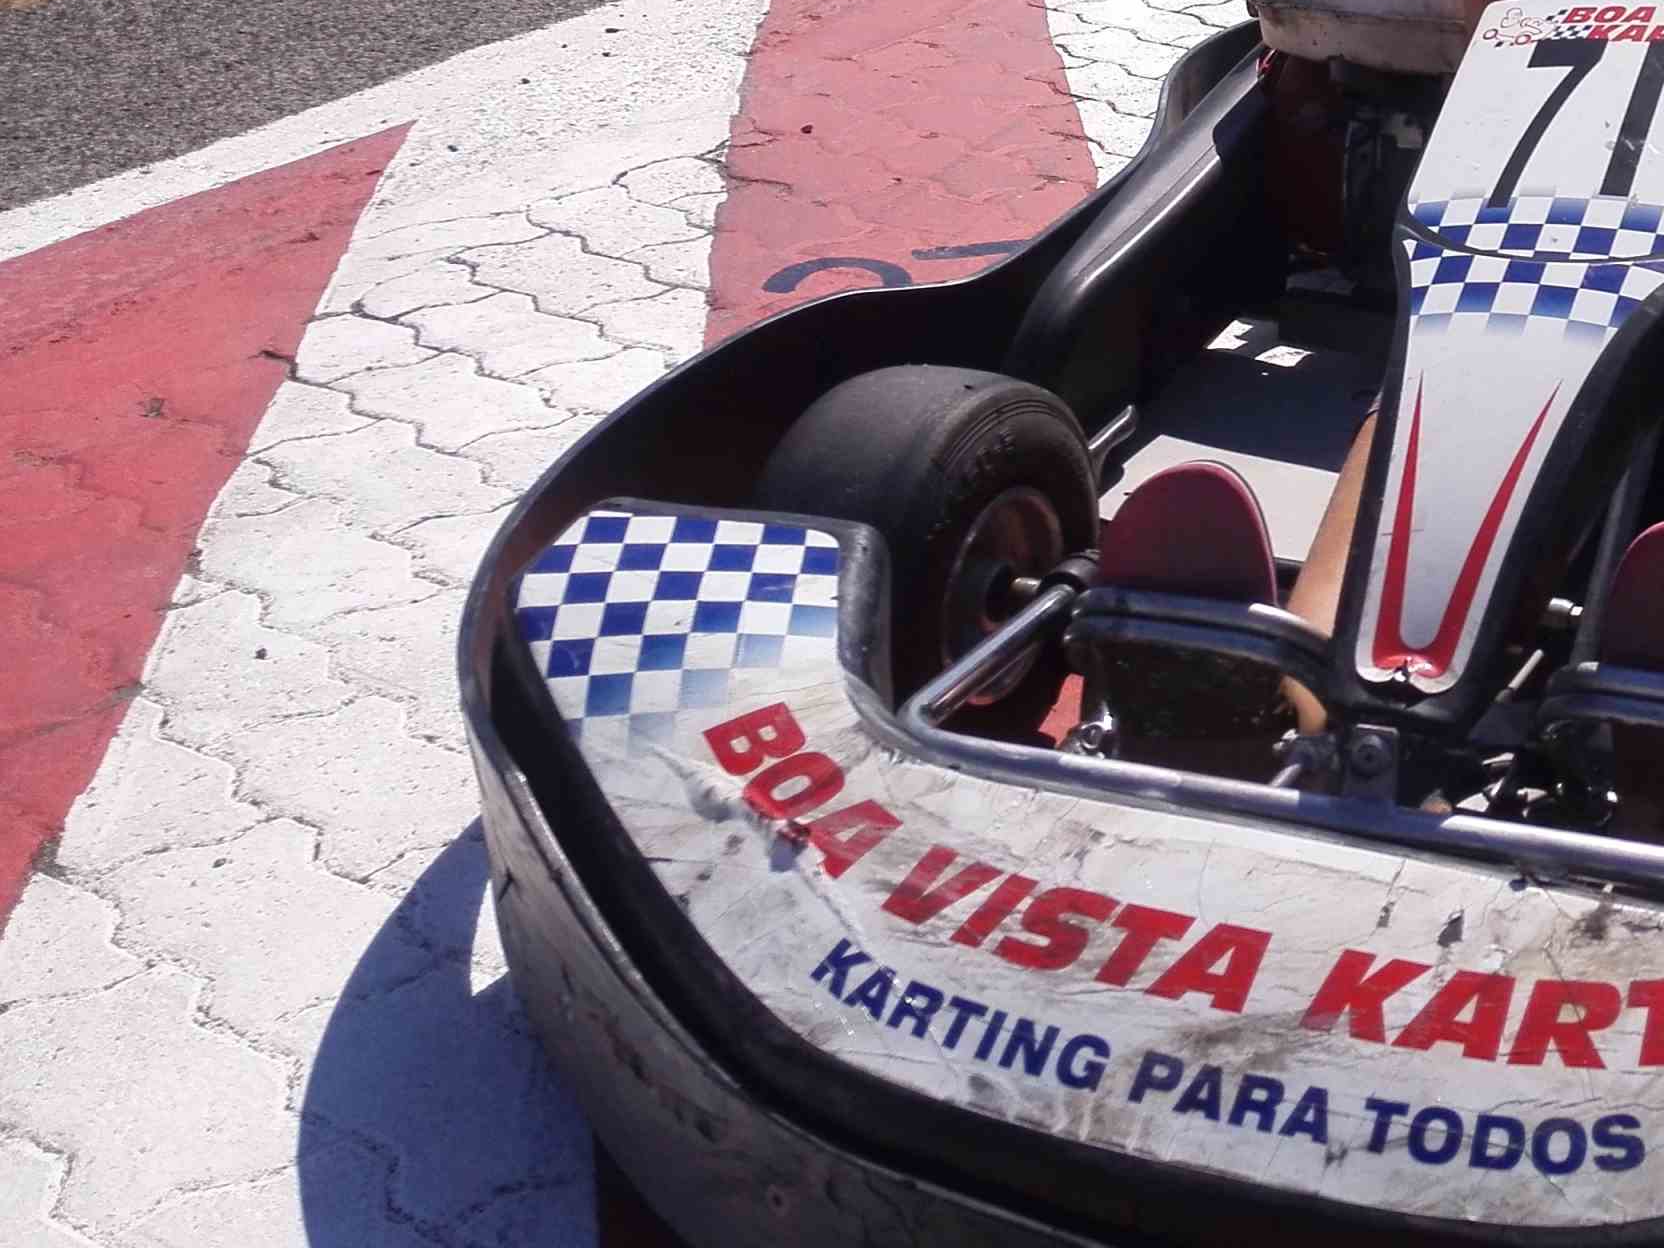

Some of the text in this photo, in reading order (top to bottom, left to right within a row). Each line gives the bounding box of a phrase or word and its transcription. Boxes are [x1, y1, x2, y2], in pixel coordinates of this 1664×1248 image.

[1561, 6, 1658, 25] BOA
[702, 701, 904, 878] BOA
[881, 846, 1273, 1013] VISTA
[810, 938, 1648, 1177] KARTING PARA TODOS
